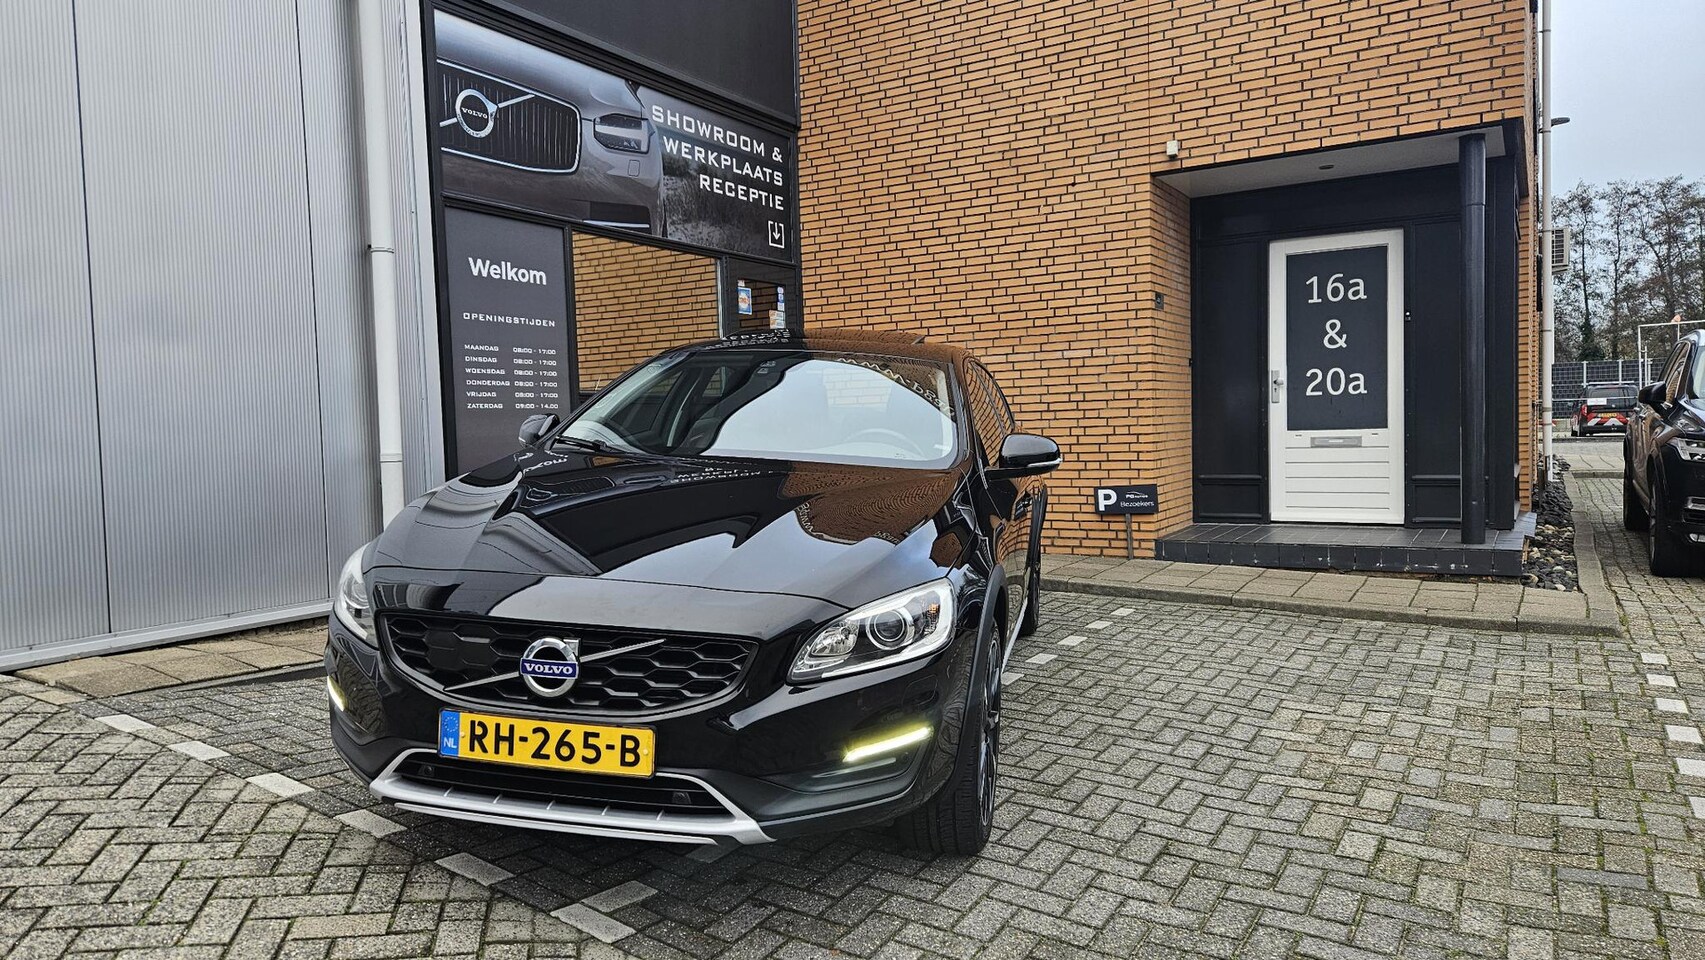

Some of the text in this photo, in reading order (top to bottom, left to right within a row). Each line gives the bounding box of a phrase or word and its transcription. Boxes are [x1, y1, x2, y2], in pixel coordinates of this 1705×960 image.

[461, 107, 488, 119] VOLVO
[651, 104, 783, 163] SHOWROOM &
[662, 135, 783, 186] WERKPLAATS
[699, 173, 784, 210] RECEPTIE
[468, 257, 547, 285] Welkom
[1305, 273, 1367, 303] 16a
[463, 312, 556, 327] OPENINGSTIJDEN
[464, 344, 499, 352] MAANDAG
[1323, 319, 1347, 349] &
[465, 367, 506, 375] WOENSDAG
[1305, 367, 1367, 396] 20a
[1097, 489, 1117, 511] P
[524, 663, 573, 675] VOLVO
[443, 719, 641, 767] NL RH-265-B
